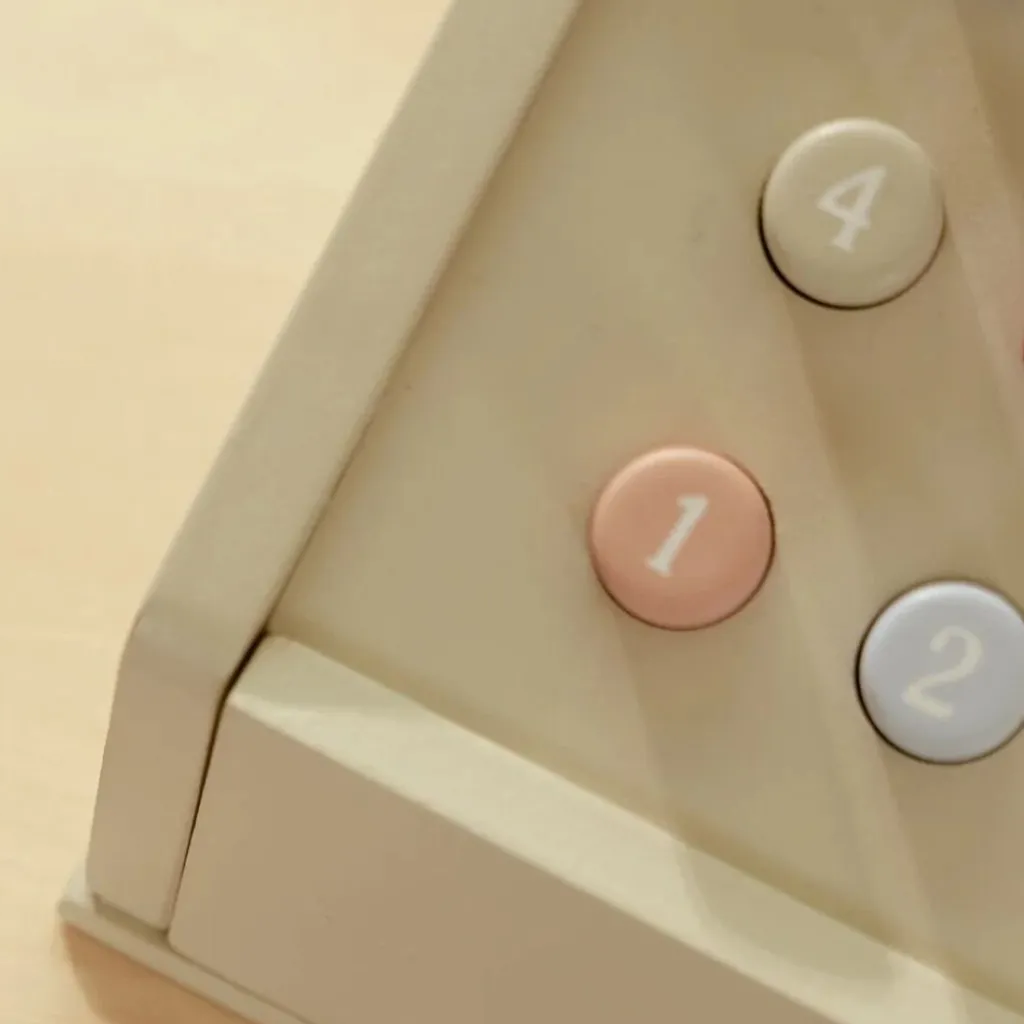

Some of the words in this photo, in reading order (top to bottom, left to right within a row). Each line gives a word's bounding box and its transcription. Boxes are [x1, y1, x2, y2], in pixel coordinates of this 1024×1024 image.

[816, 165, 887, 252] 4
[645, 493, 708, 577] 1
[902, 625, 982, 720] 2
